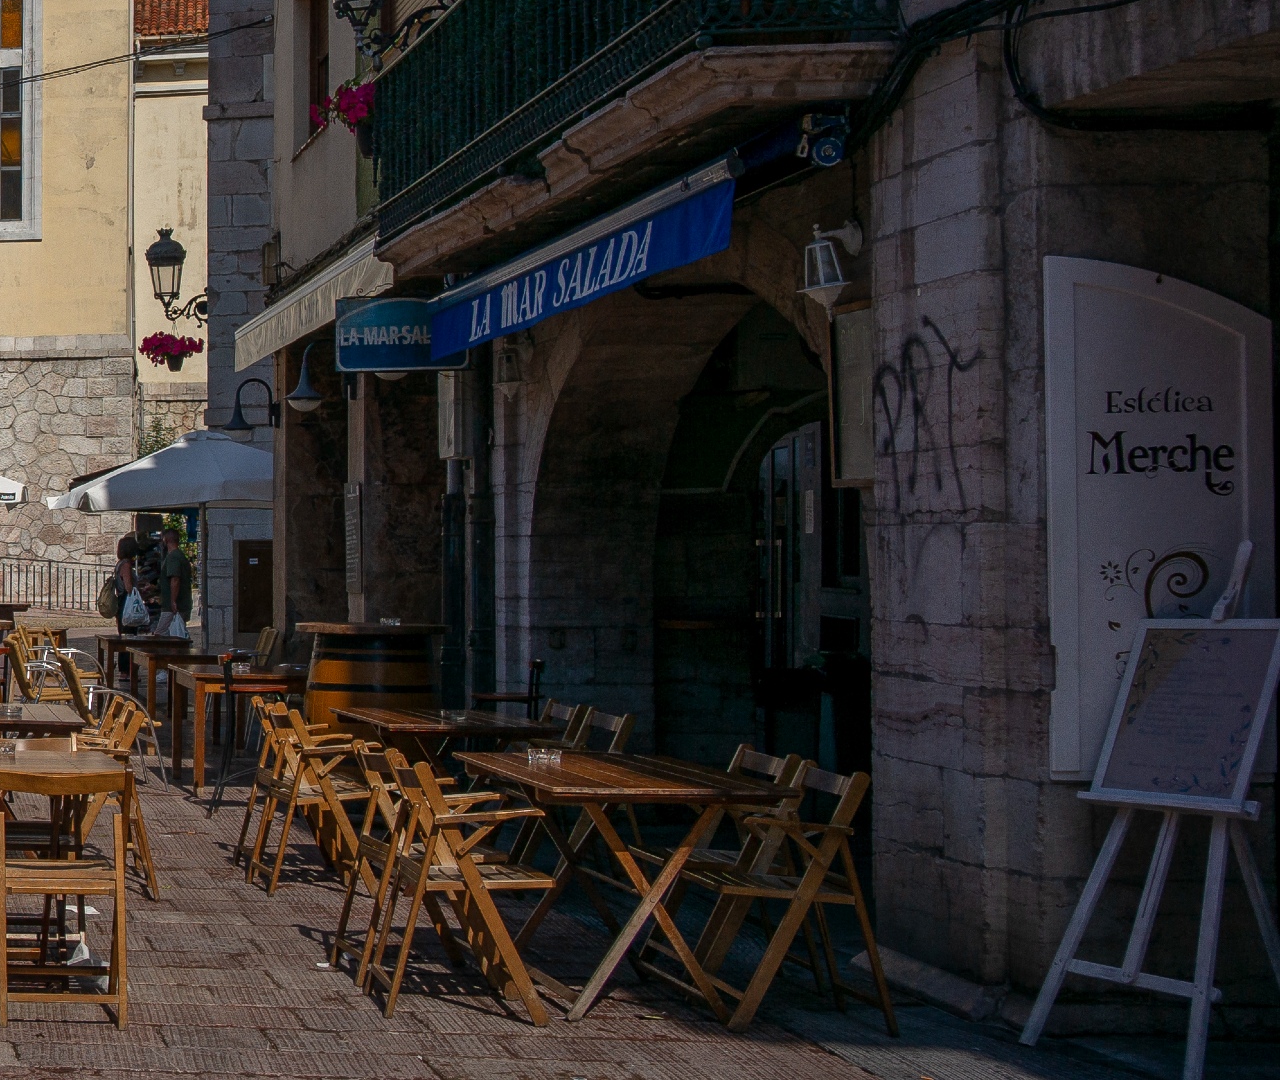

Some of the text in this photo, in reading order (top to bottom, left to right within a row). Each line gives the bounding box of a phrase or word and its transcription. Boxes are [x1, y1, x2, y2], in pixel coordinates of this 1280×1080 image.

[469, 220, 653, 342] LA MAR SALADA
[340, 327, 360, 346] LA
[364, 325, 400, 345] MAR
[1105, 386, 1214, 414] Estética
[1085, 431, 1235, 496] Merche
